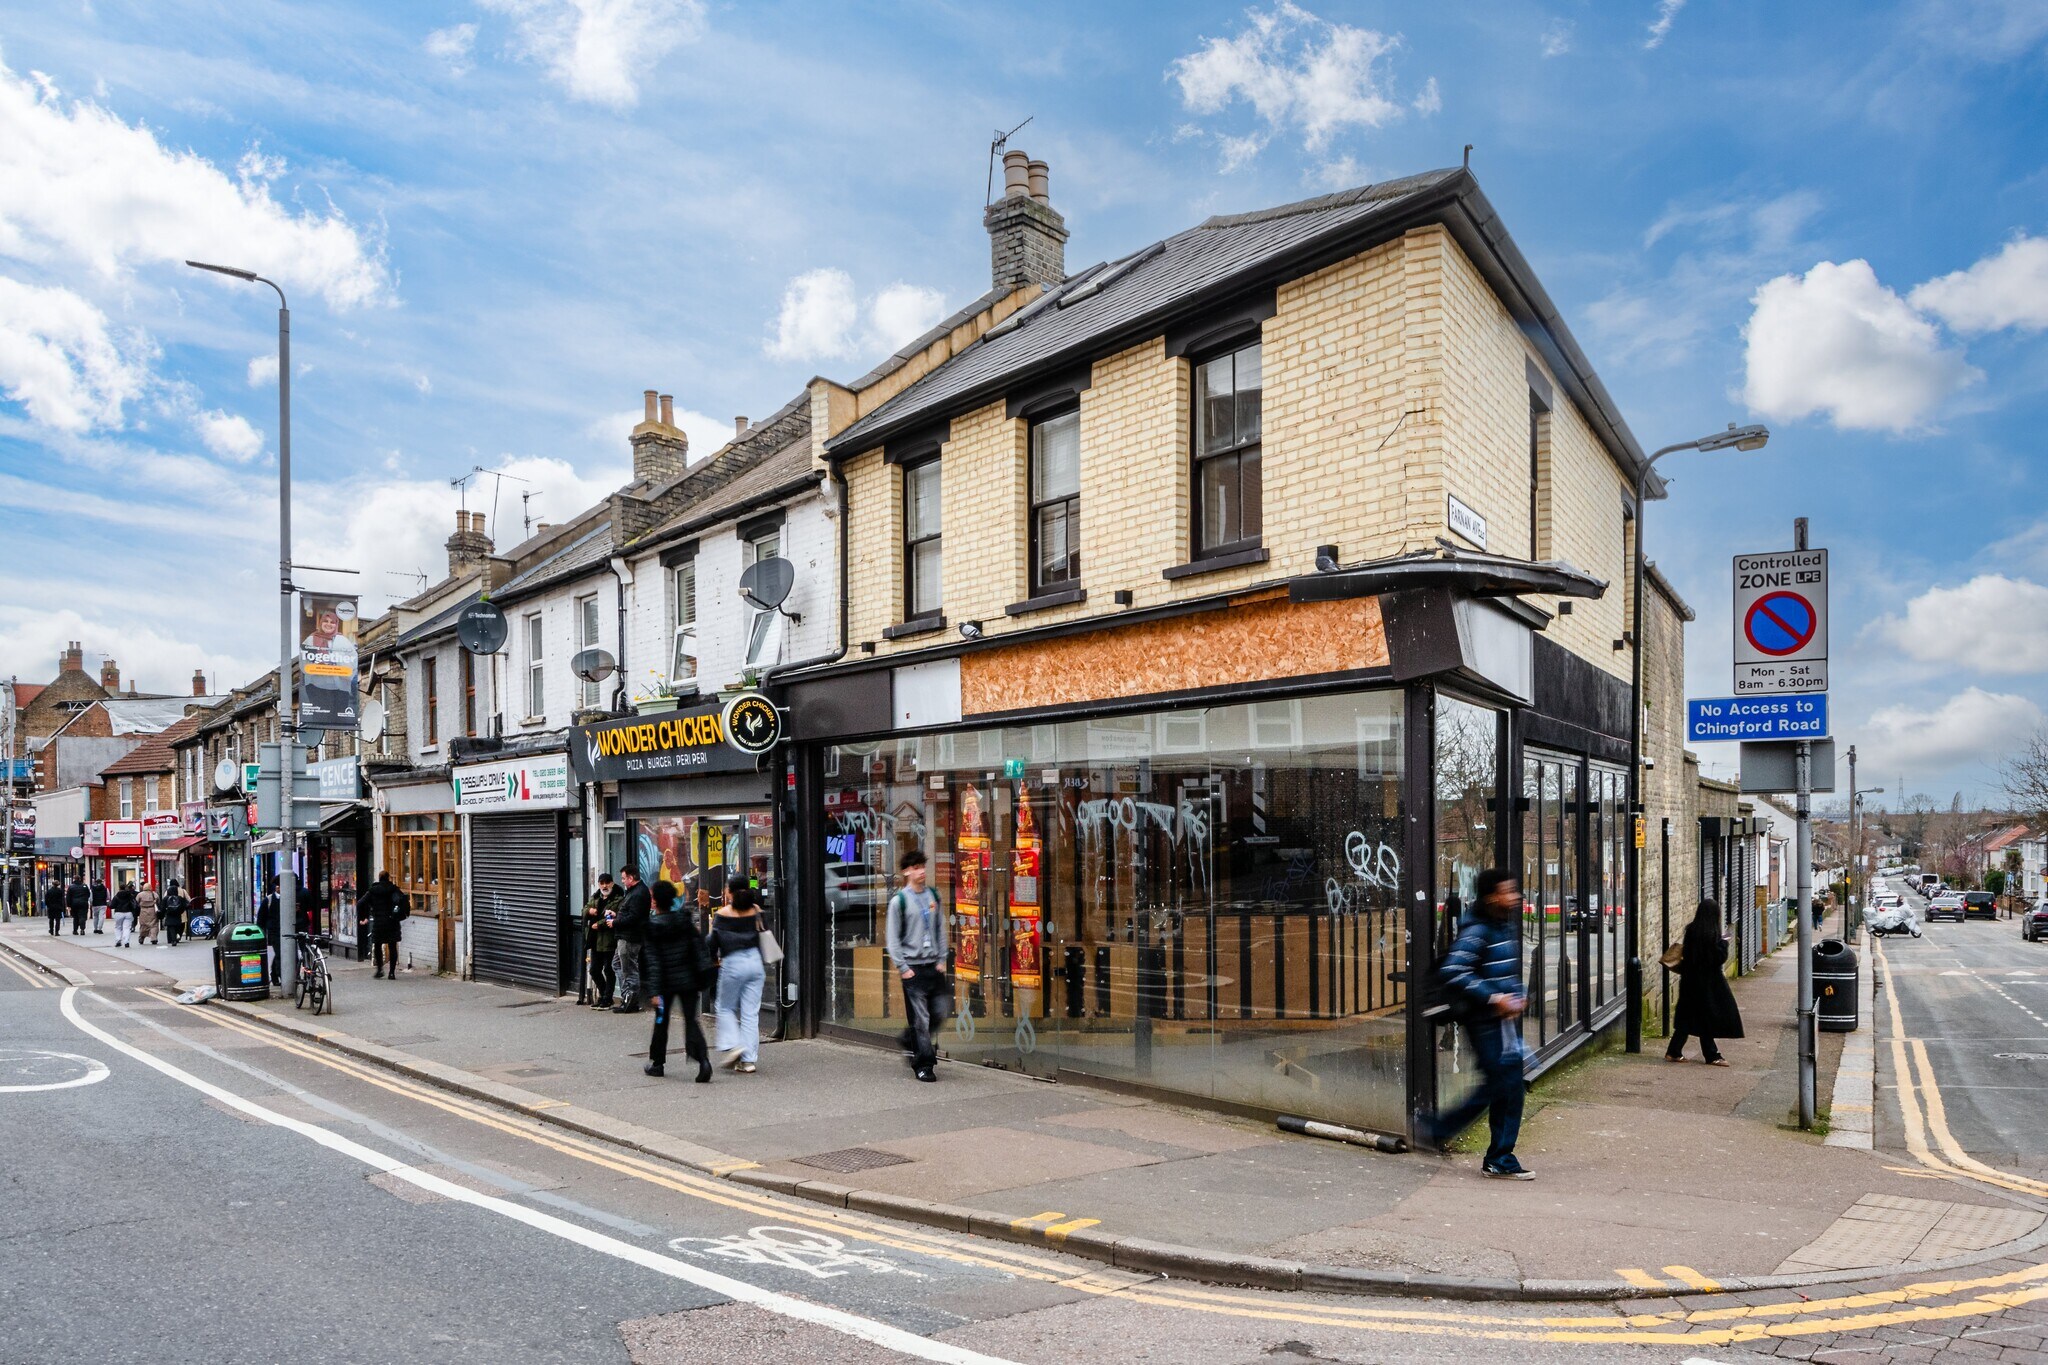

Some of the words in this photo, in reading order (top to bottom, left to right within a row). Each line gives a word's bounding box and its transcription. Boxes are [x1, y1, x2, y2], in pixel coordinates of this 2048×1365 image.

[1739, 553, 1821, 571] Controlled
[1740, 572, 1791, 589] ZONE
[1796, 571, 1820, 583] LPE
[301, 651, 355, 664] Together
[1751, 667, 1775, 677] Mon
[1790, 665, 1810, 675] Sat
[1739, 679, 1763, 689] 8am
[1778, 677, 1823, 688] 6.30pm
[732, 701, 751, 726] WONDER
[752, 700, 775, 722] CHICKEN
[1700, 705, 1721, 717] No
[1729, 703, 1788, 715] Access
[1796, 701, 1813, 712] to
[597, 724, 657, 756] WONDER
[658, 713, 724, 749] CHICKEN
[1695, 721, 1772, 735] Chingford
[1779, 718, 1820, 731] Road
[626, 760, 644, 771] PIZZA
[647, 756, 671, 769] BURGER
[676, 754, 690, 766] PERI
[692, 752, 708, 765] PERI
[461, 774, 488, 788] PASSWAY
[489, 772, 506, 785] DRIVE
[462, 798, 478, 806] SCHOOL
[485, 795, 506, 804] MOTORING
